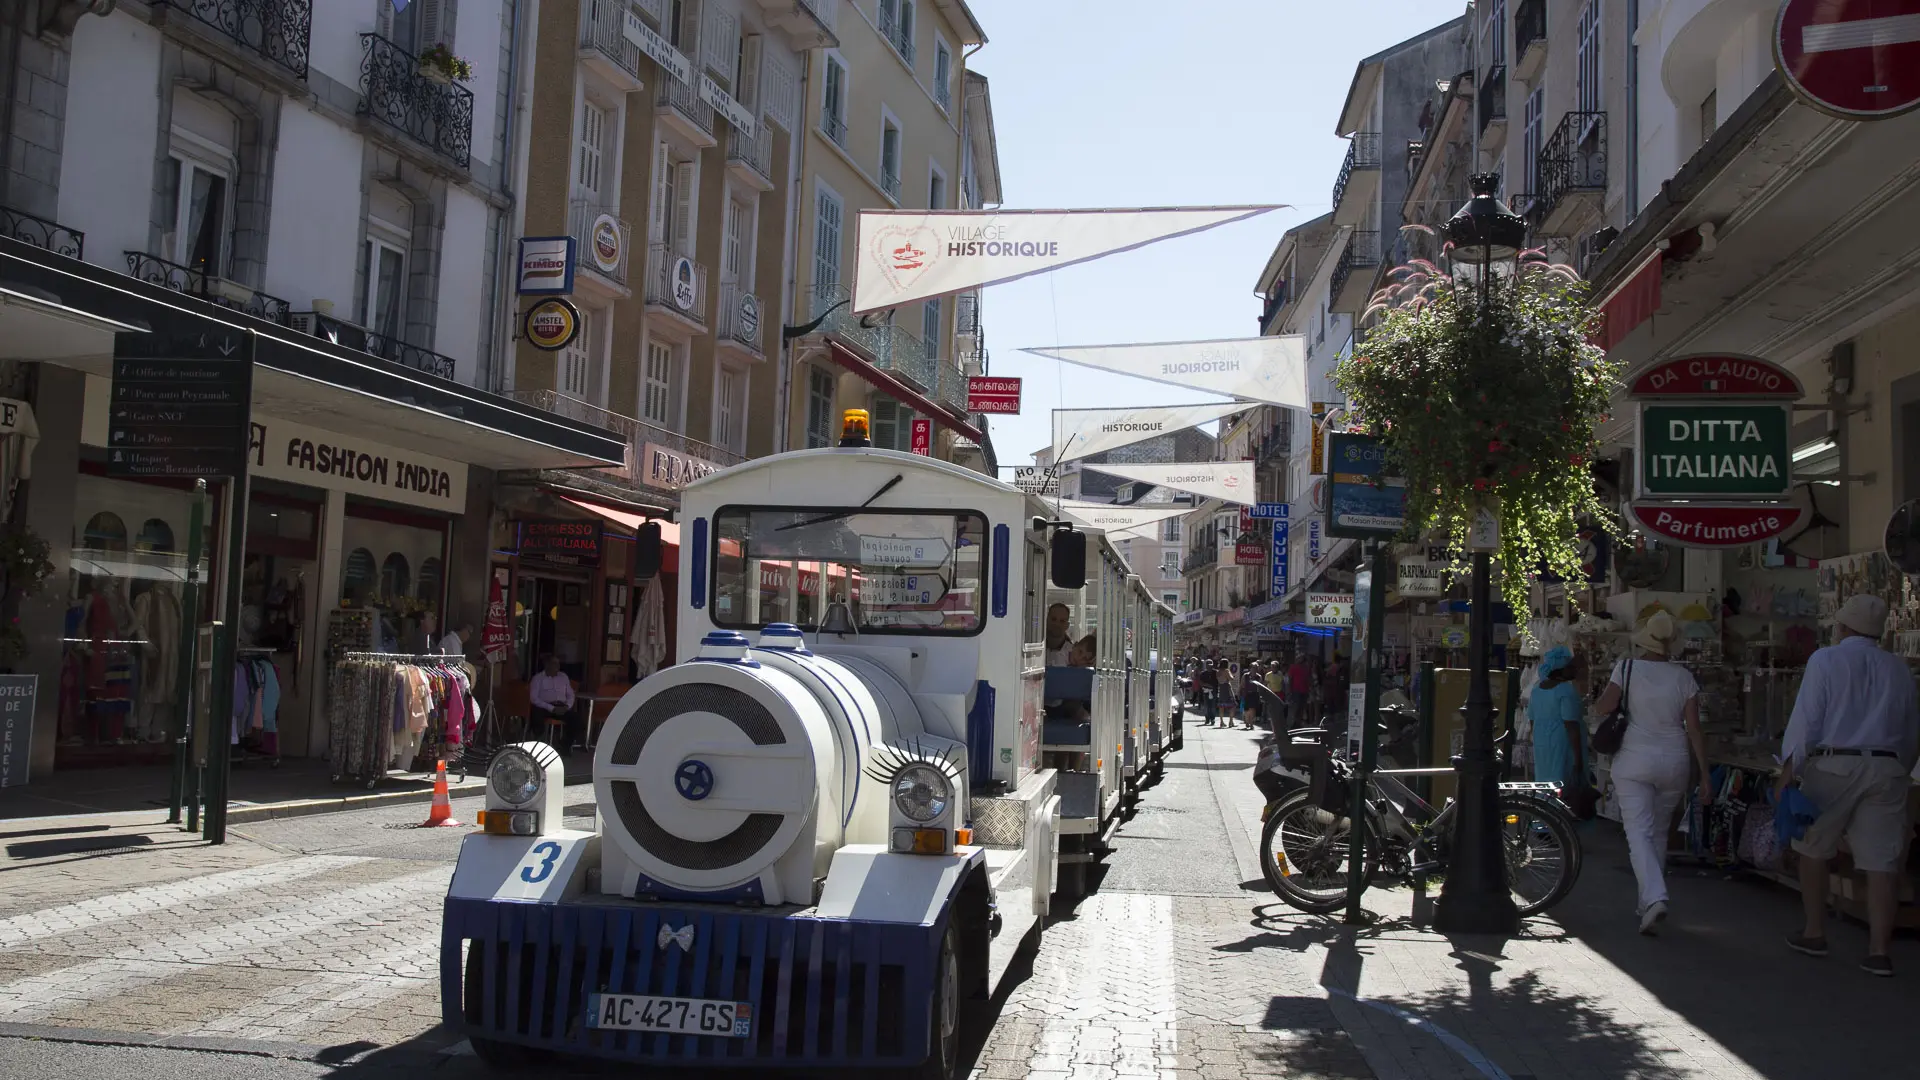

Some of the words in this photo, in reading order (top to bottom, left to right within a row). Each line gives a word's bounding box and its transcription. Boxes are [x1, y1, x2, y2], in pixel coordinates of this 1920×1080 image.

[948, 225, 1005, 240] VILLAGE
[598, 233, 615, 248] AMSTEL
[948, 242, 1058, 257] HISTORIQUE
[524, 261, 564, 269] KIMBO
[676, 283, 692, 306] Leffe
[535, 316, 563, 325] AMSTEL
[1649, 368, 1679, 390] DA
[1688, 361, 1781, 390] CLAUDIO
[135, 390, 156, 399] Parc
[158, 391, 179, 399] auto
[133, 412, 155, 421] Gare
[158, 411, 185, 421] SNCF
[1102, 423, 1163, 433] HISTORIQUE
[1669, 420, 1762, 442] DITTA
[132, 433, 145, 443] La
[148, 433, 173, 443] Poste
[130, 453, 170, 464] Hospice
[287, 438, 389, 485] FASHION
[395, 460, 450, 498] INDIA
[1652, 455, 1780, 479] ITALIANA
[1252, 505, 1287, 517] HOTEL
[1347, 516, 1371, 525] Maison
[1656, 511, 1781, 540] Parfumerie
[528, 523, 593, 536] ESPRESSO
[1310, 521, 1320, 558] SENG
[1240, 545, 1264, 555] HOTEL
[1273, 537, 1287, 595] JULIEN
[1399, 564, 1439, 579] PARFUMERIE
[1314, 617, 1337, 625] DALLO
[5, 701, 21, 712] DE
[1, 718, 14, 788] GENEVE
[520, 841, 562, 883] 3
[602, 997, 734, 1032] AC-427-GS
[734, 1020, 749, 1035] 65
